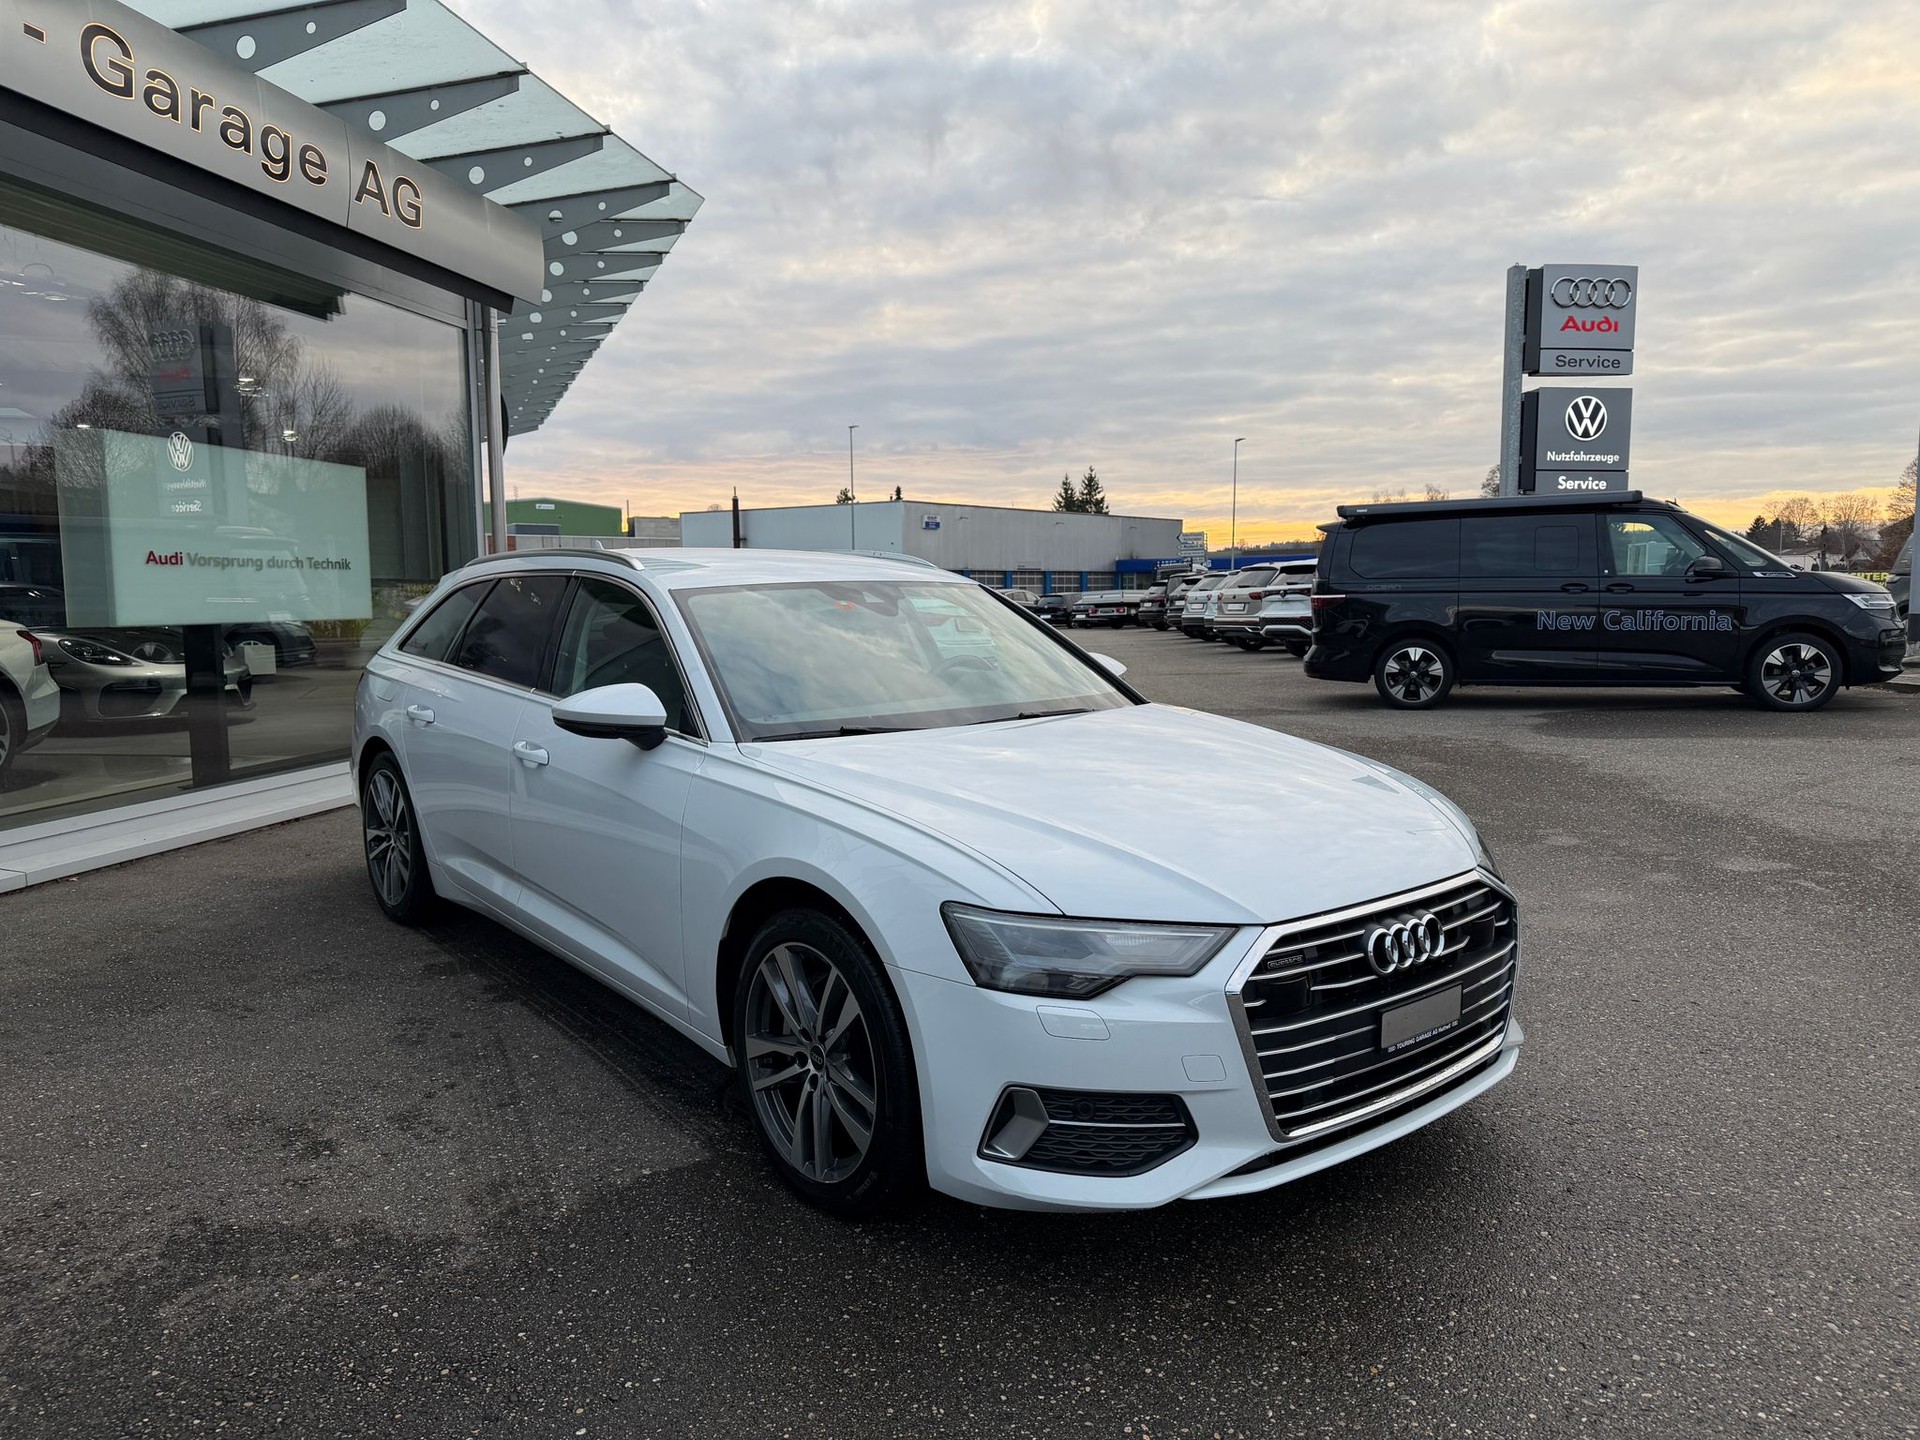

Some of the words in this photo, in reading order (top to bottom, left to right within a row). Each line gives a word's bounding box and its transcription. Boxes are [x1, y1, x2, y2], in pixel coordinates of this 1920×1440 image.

[79, 21, 329, 188] Garage
[354, 158, 423, 230] AG
[1559, 315, 1619, 334] Audi
[1555, 354, 1621, 369] Service
[1546, 451, 1620, 464] Nutzfahrzeuge
[1557, 475, 1607, 490] Service
[145, 550, 184, 566] Audi
[186, 552, 264, 572] Vorsprung
[266, 555, 304, 570] durch
[306, 556, 352, 571] Technik
[1537, 610, 1596, 631] New
[1603, 609, 1734, 631] California
